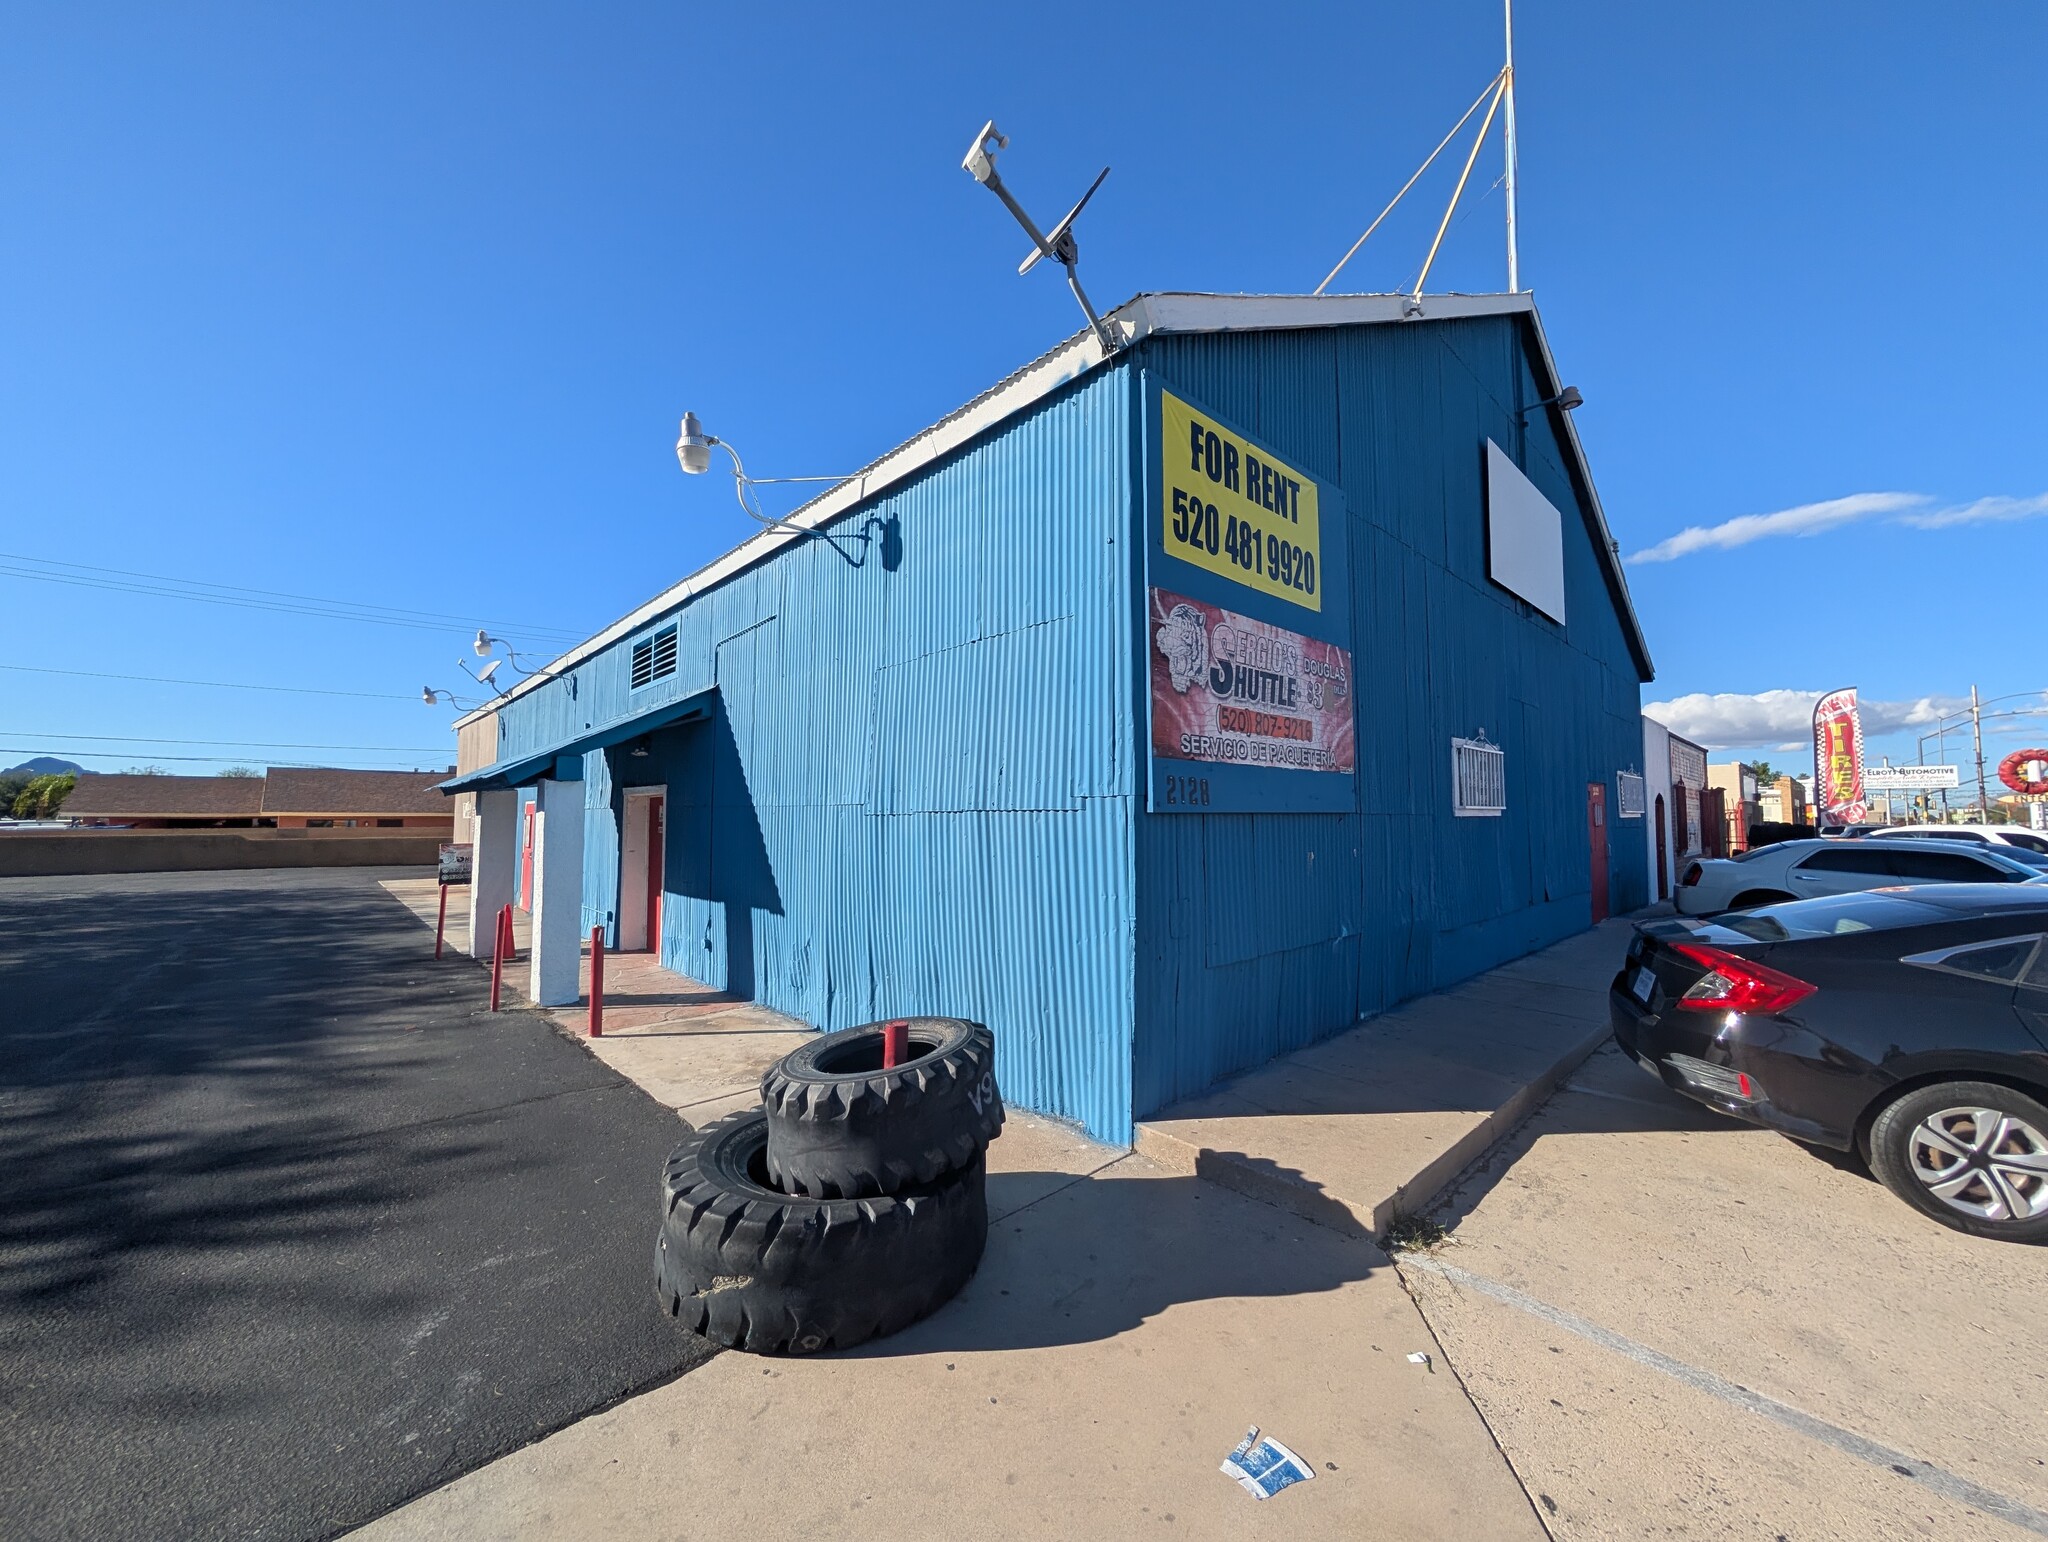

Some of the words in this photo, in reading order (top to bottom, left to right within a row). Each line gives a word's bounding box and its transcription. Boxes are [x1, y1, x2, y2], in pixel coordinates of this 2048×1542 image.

[1190, 420, 1240, 494] FOR
[1246, 453, 1300, 525] RENT
[1173, 486, 1219, 556] 520
[1225, 515, 1262, 575] 481
[1267, 534, 1315, 595] 9920
[1209, 657, 1297, 707] SHUTTLE
[1304, 657, 1346, 682] DOUGLAS
[1216, 704, 1251, 737] (520)
[1818, 693, 1856, 717] NEW
[1180, 733, 1248, 762] SERVICIO
[1251, 741, 1267, 762] DE
[1270, 743, 1338, 769] PAQUETERÍA
[1828, 722, 1854, 800] TIRES
[1899, 767, 1954, 776] AUTOMOTIVE
[1825, 804, 1867, 825] USED
